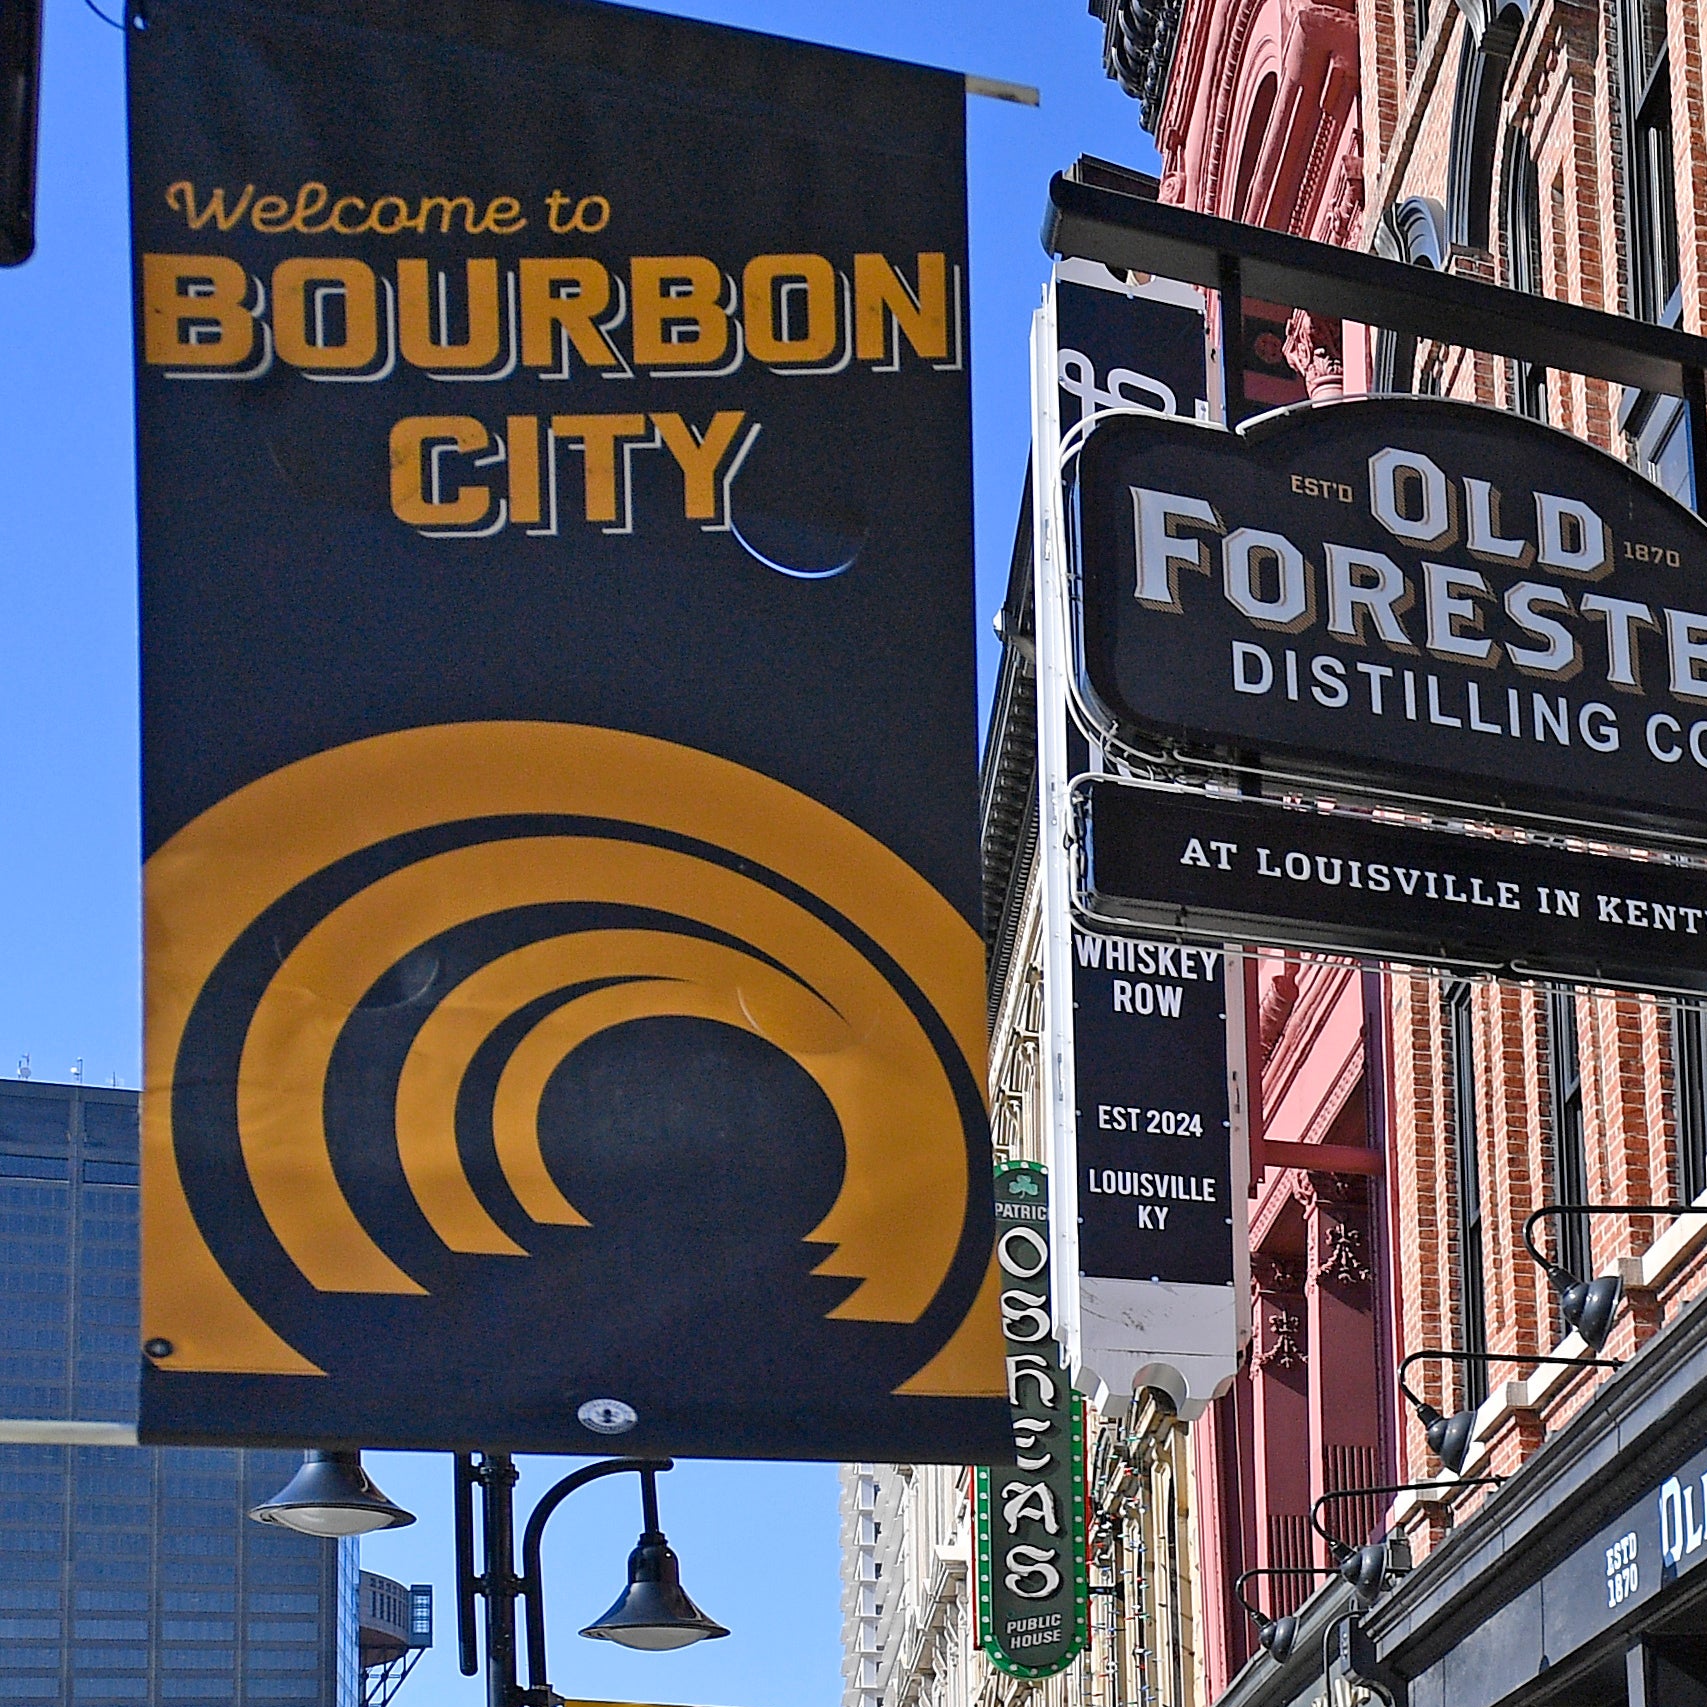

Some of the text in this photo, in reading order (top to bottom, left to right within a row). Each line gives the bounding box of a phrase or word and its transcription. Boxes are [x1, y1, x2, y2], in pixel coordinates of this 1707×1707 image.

[166, 180, 611, 235] Welcome to
[142, 252, 963, 382] BOURBON
[389, 410, 762, 538] CITY
[1367, 445, 1614, 580] OLD
[1623, 542, 1682, 568] 1870
[1232, 640, 1621, 754] DISTILLING
[1180, 837, 1237, 871] AT
[1256, 847, 1521, 911] LOUISVILLE
[1538, 886, 1580, 918] IN
[1074, 934, 1219, 982] WHISKEY
[1113, 979, 1183, 1018] ROW
[1098, 1104, 1203, 1139] EST 2024
[1088, 1168, 1216, 1203] LOUISVILLE
[994, 1202, 1048, 1221] PATRIC
[1138, 1203, 1170, 1232] KY
[1605, 1531, 1638, 1577] ESTD
[1607, 1562, 1639, 1609] 1870
[1007, 1613, 1061, 1634] PUBLIC
[1011, 1629, 1061, 1649] HOUSE
